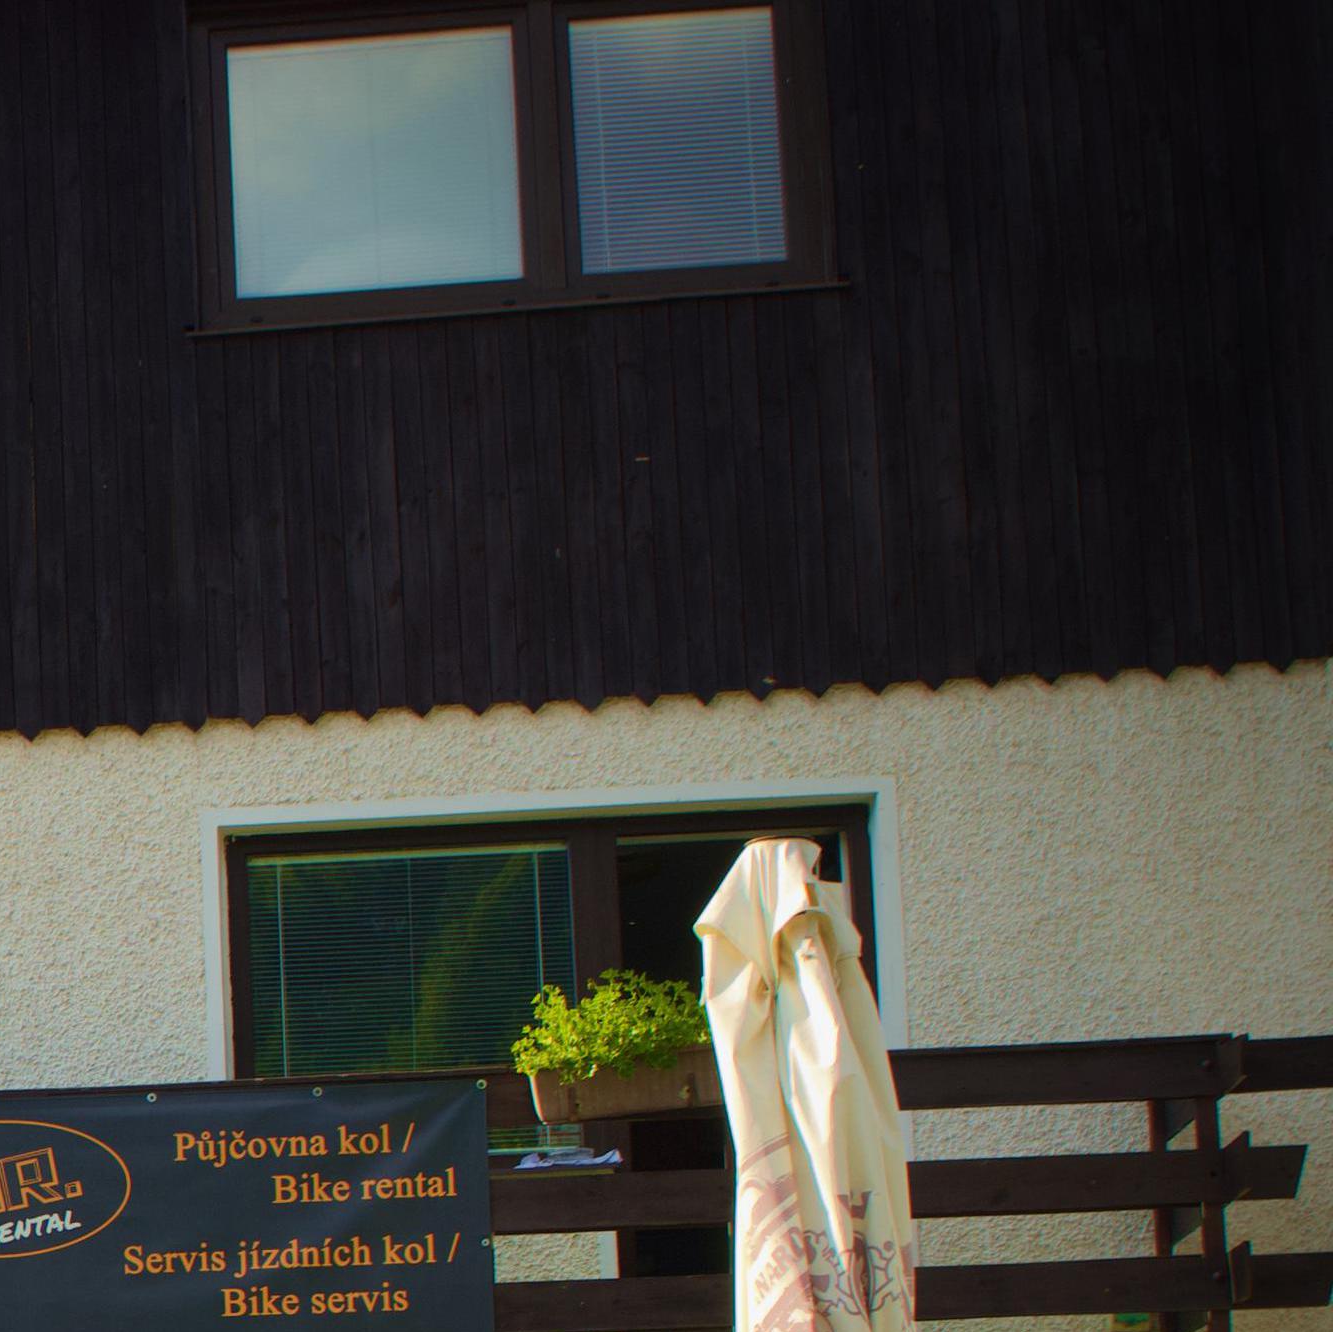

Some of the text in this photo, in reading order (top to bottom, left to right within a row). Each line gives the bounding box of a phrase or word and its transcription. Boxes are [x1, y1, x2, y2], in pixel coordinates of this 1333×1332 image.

[173, 1130, 328, 1168] Půjčovna
[337, 1123, 391, 1155] kol
[272, 1166, 457, 1204] Bike rental
[124, 1242, 227, 1275] Servis
[234, 1236, 373, 1278] jízdních
[382, 1232, 437, 1264] kol
[221, 1281, 410, 1317] Bike servis
